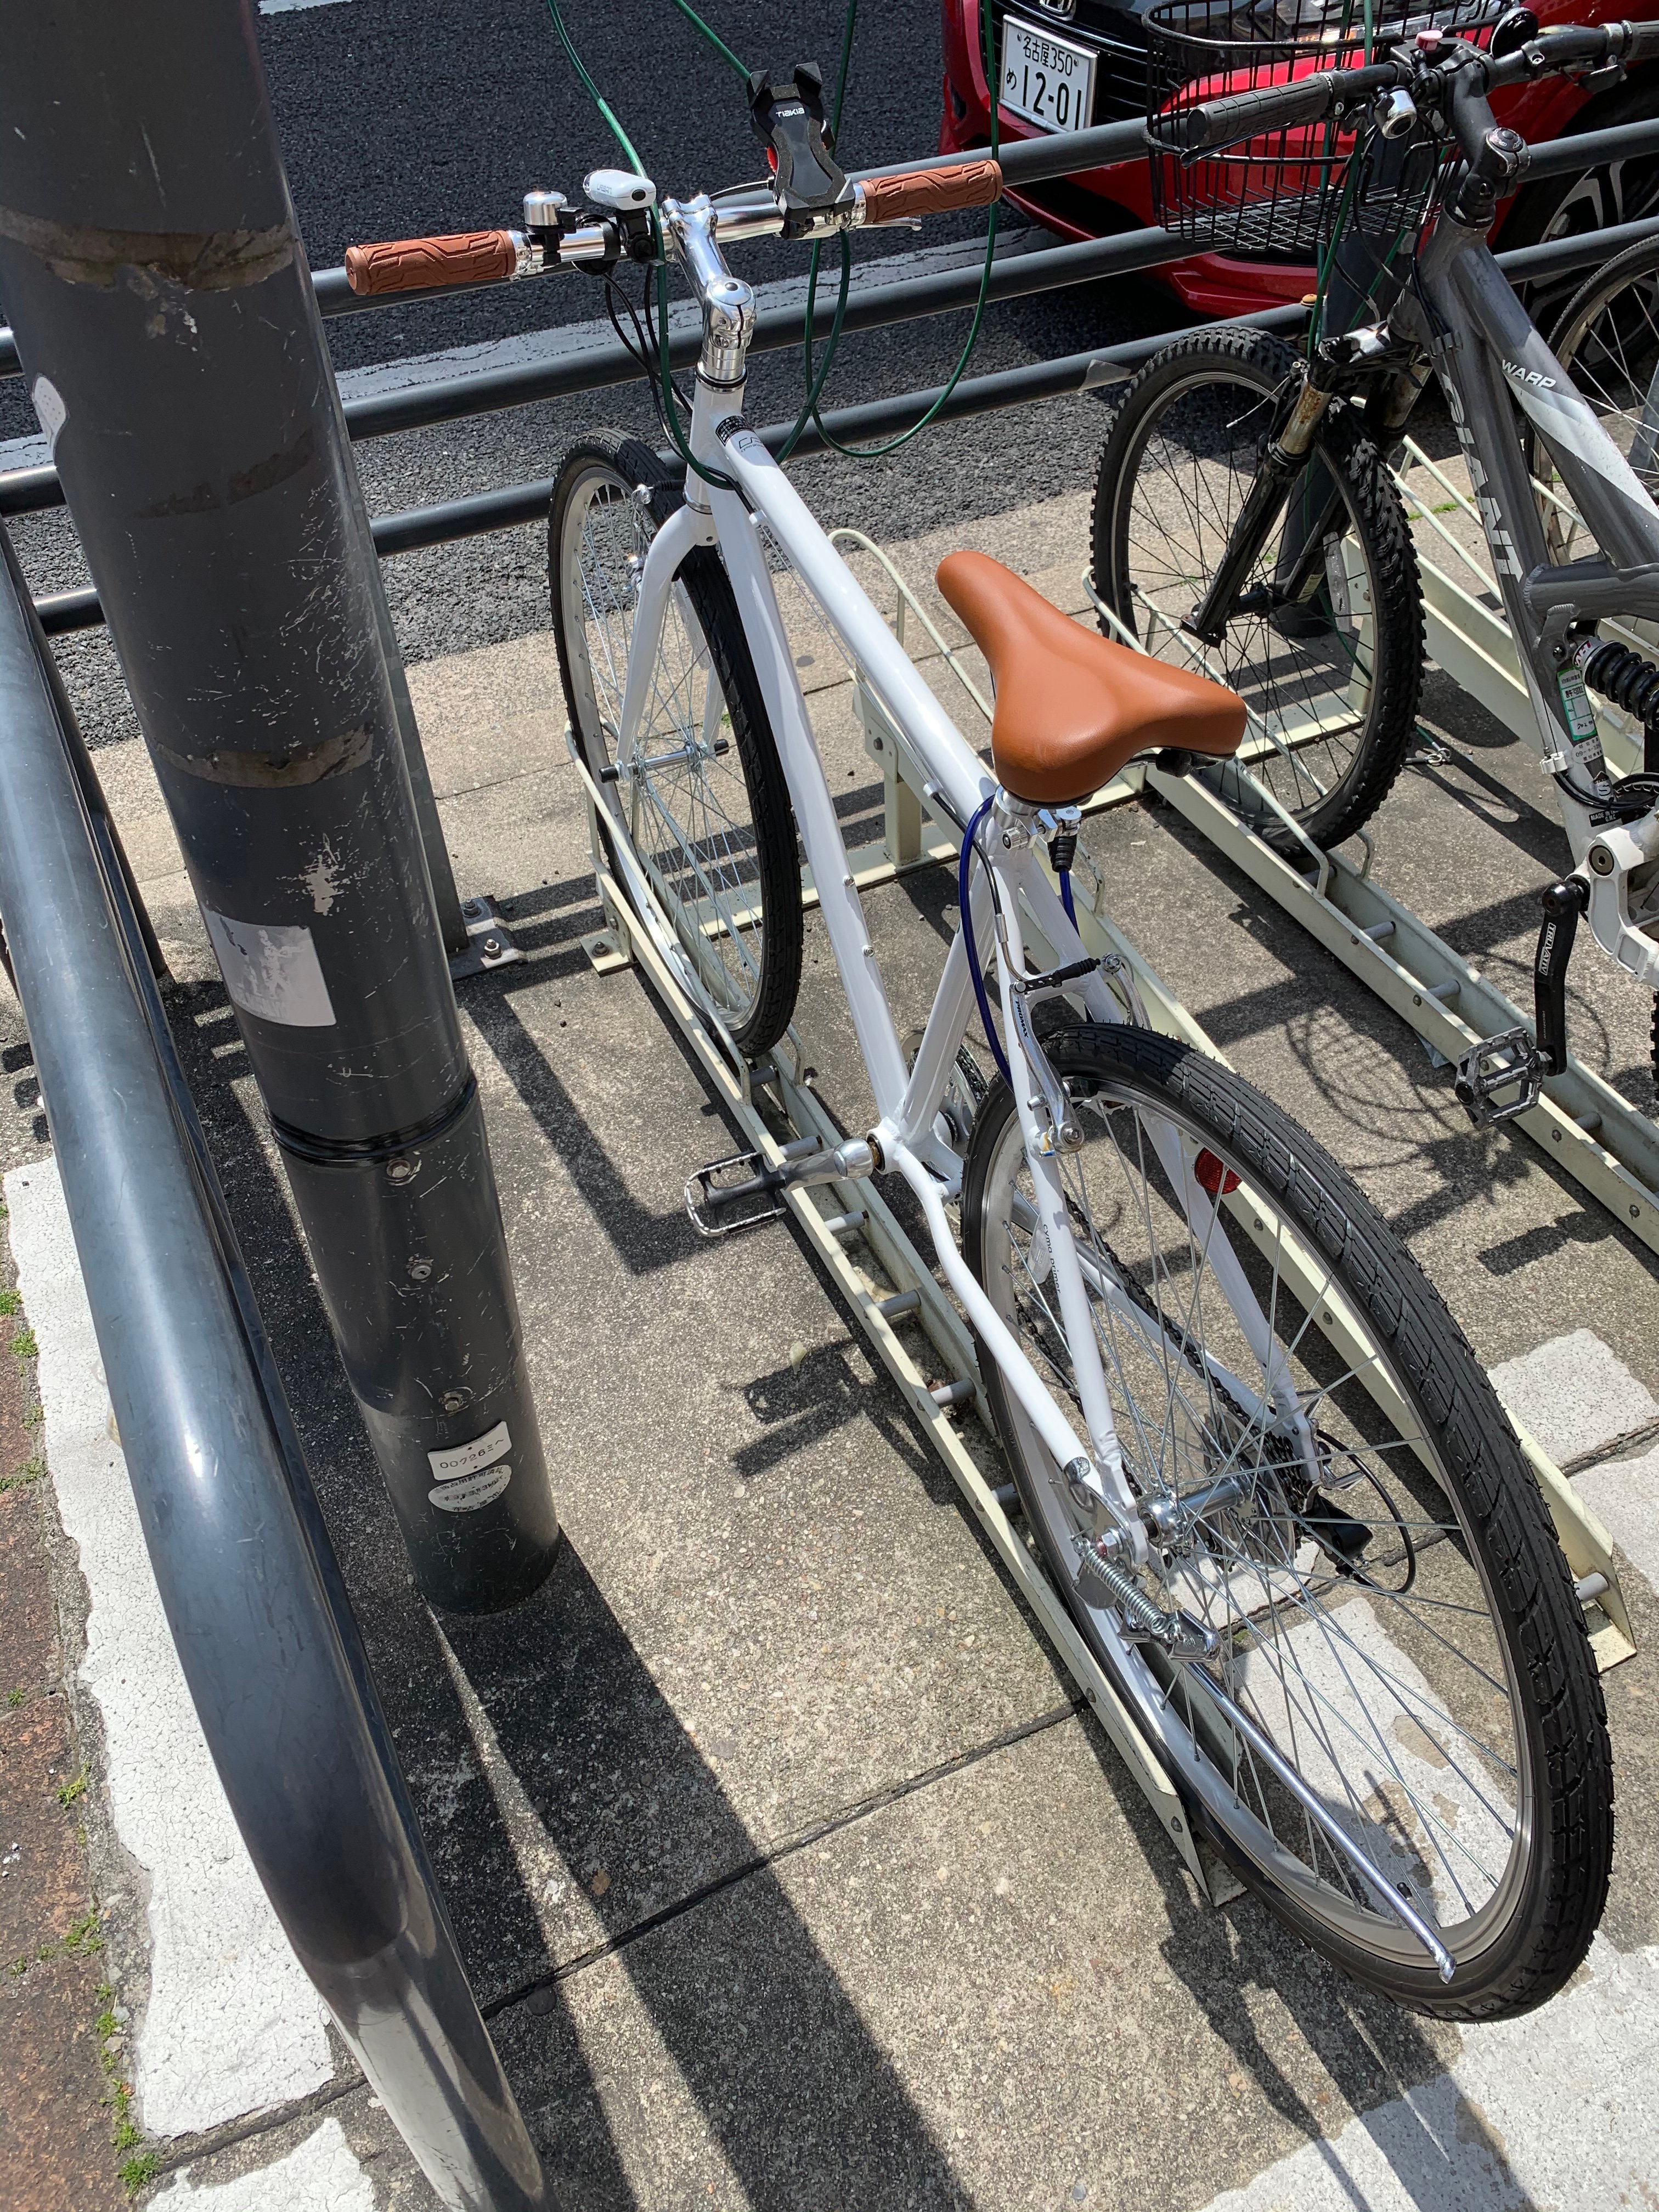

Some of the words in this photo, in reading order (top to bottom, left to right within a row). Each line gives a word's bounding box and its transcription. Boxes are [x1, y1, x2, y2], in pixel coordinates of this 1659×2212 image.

[1023, 35, 1073, 76] 名古屋350
[1006, 67, 1017, 90] め
[1023, 64, 1082, 131] 12-01
[1502, 358, 1557, 388] WARP
[1541, 924, 1556, 975] TRUVATIV
[1015, 1001, 1029, 1039] PROMAX
[1043, 1224, 1053, 1253] cyma
[1050, 1258, 1061, 1294] primer
